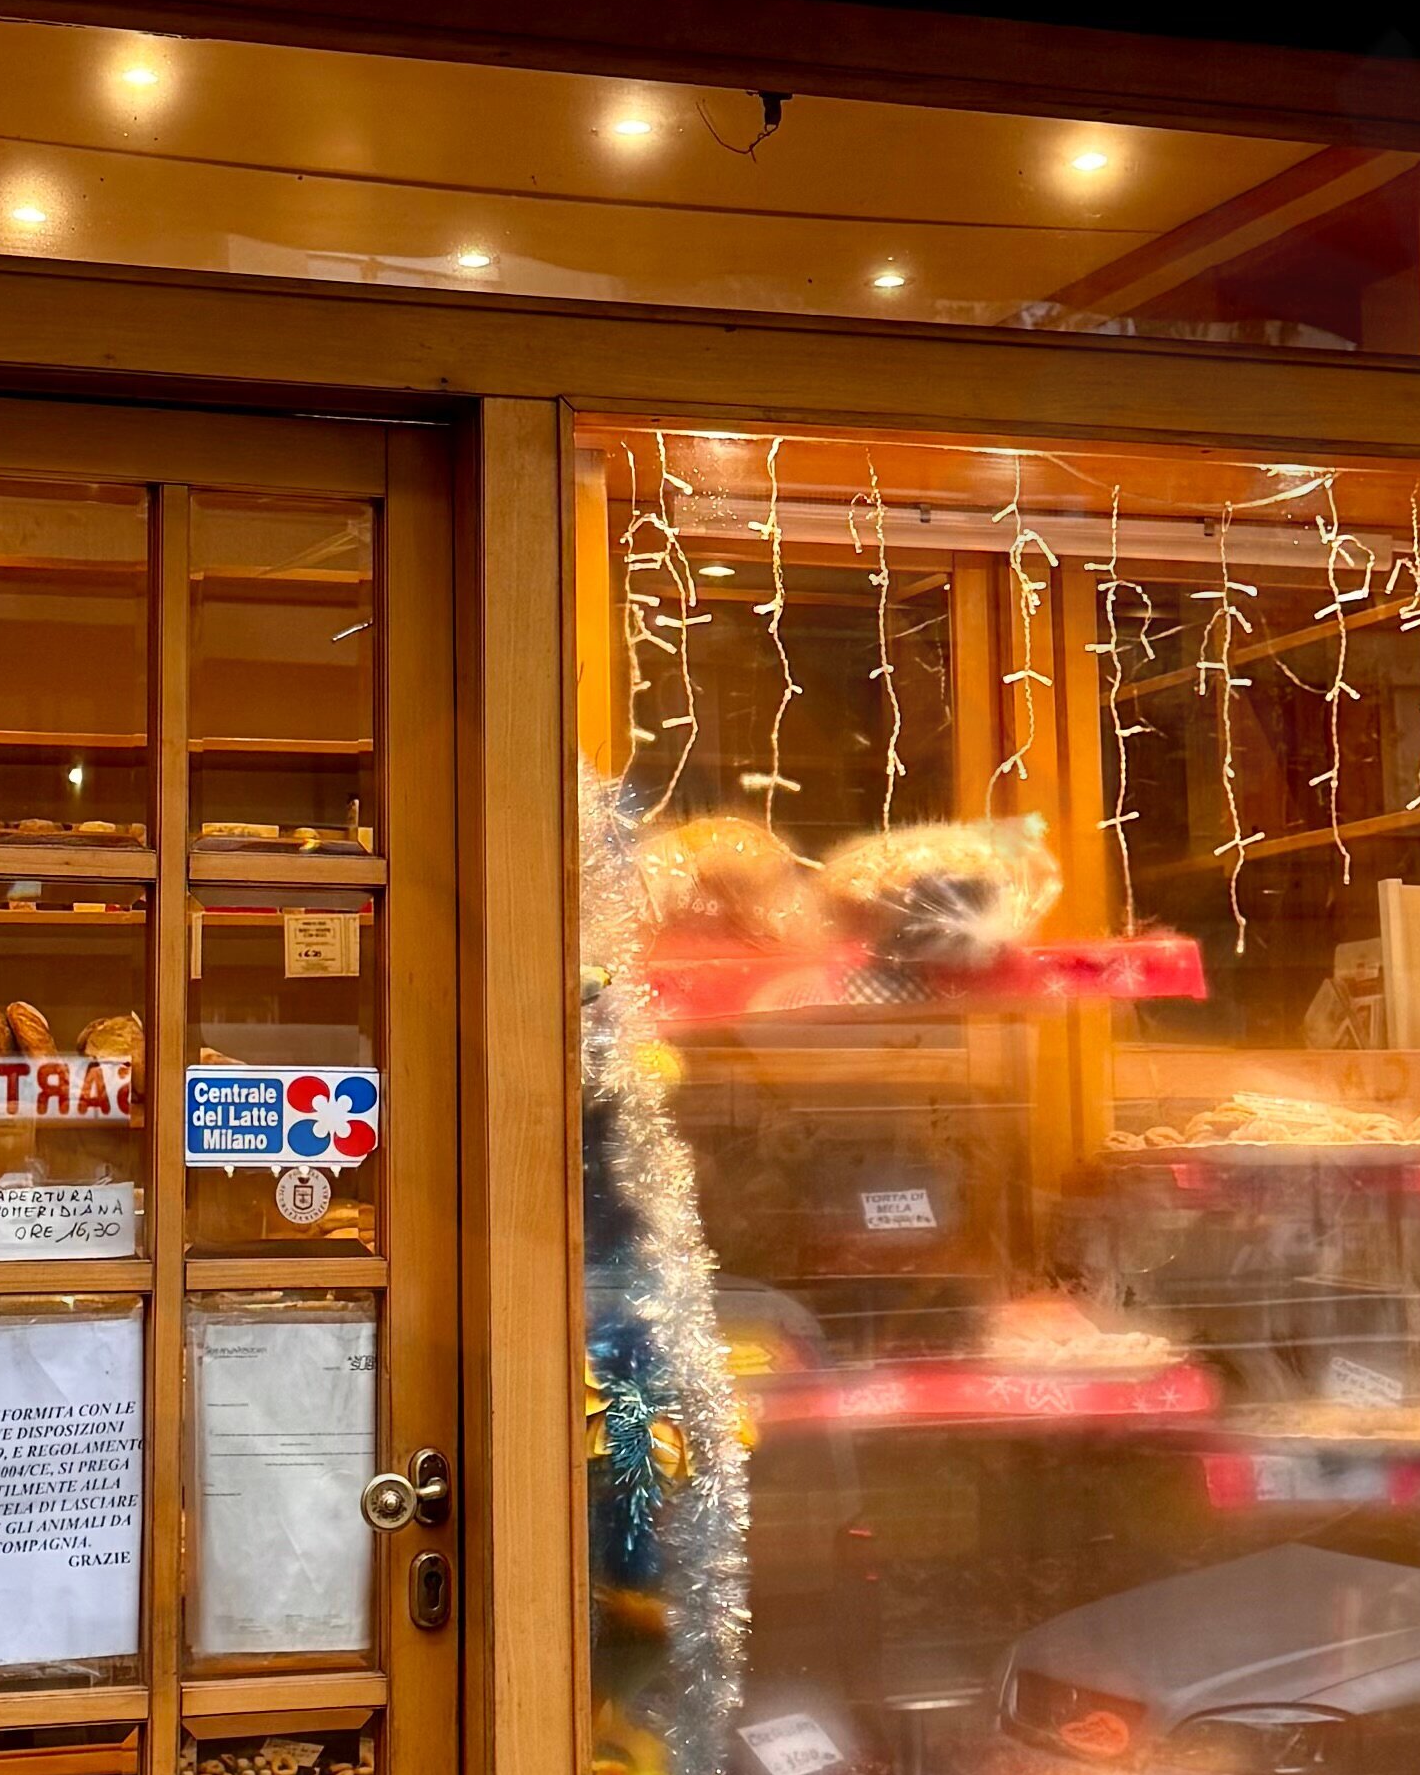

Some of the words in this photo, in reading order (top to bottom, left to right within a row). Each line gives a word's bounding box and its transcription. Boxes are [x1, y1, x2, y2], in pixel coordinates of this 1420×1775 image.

[194, 1082, 277, 1104] Centrale
[192, 1105, 222, 1127] del
[227, 1107, 279, 1127] Latte
[203, 1129, 268, 1150] Milano
[15, 1223, 54, 1240] ORE
[55, 1221, 121, 1243] 16,30
[78, 1402, 112, 1417] CON
[115, 1400, 137, 1415] LE
[16, 1420, 125, 1440] DISPOSIZIONI
[12, 1446, 24, 1460] E
[57, 1461, 74, 1475] SI
[78, 1458, 130, 1474] PREGA
[80, 1477, 121, 1492] ALLA
[39, 1499, 57, 1514] DI
[60, 1494, 139, 1513] LASCIARE
[5, 1521, 34, 1536] GLI
[36, 1515, 107, 1534] ANIMALI
[110, 1514, 132, 1528] DA
[68, 1551, 132, 1568] GRAZIE
